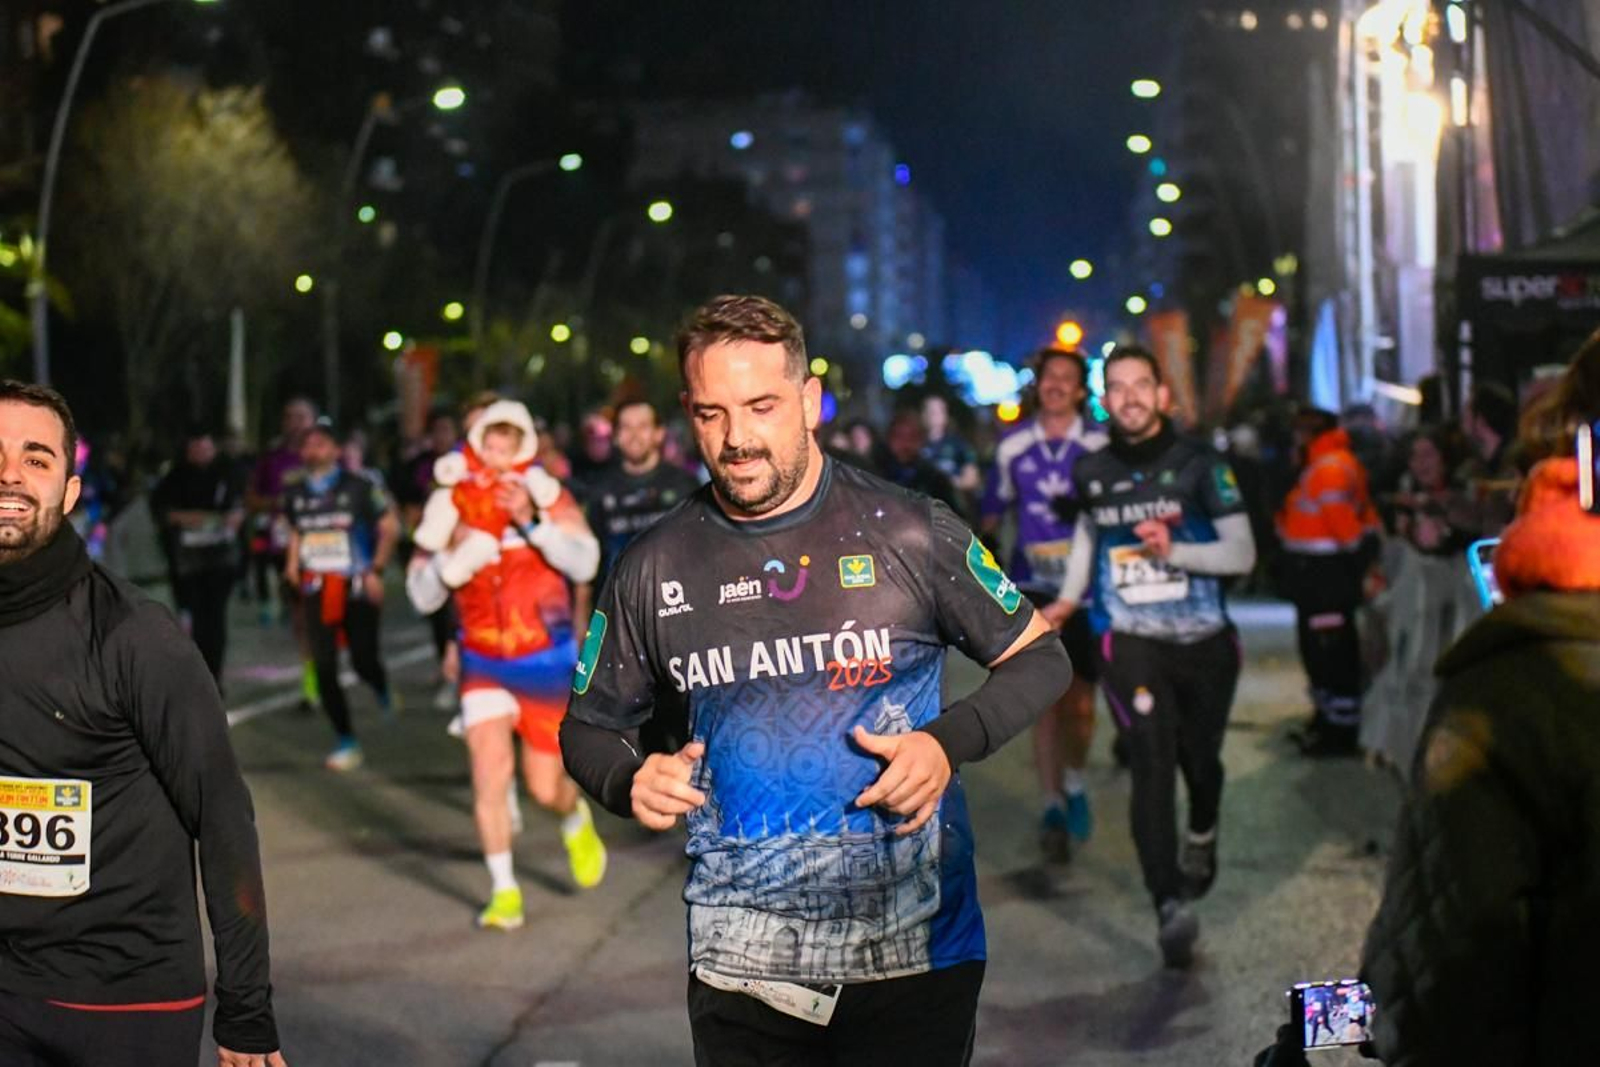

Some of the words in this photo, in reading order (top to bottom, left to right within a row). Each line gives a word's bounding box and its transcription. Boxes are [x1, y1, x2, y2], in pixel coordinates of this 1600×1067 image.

[669, 646, 736, 692] SAN
[750, 620, 891, 679] ANTÓN
[827, 656, 893, 691] 2025
